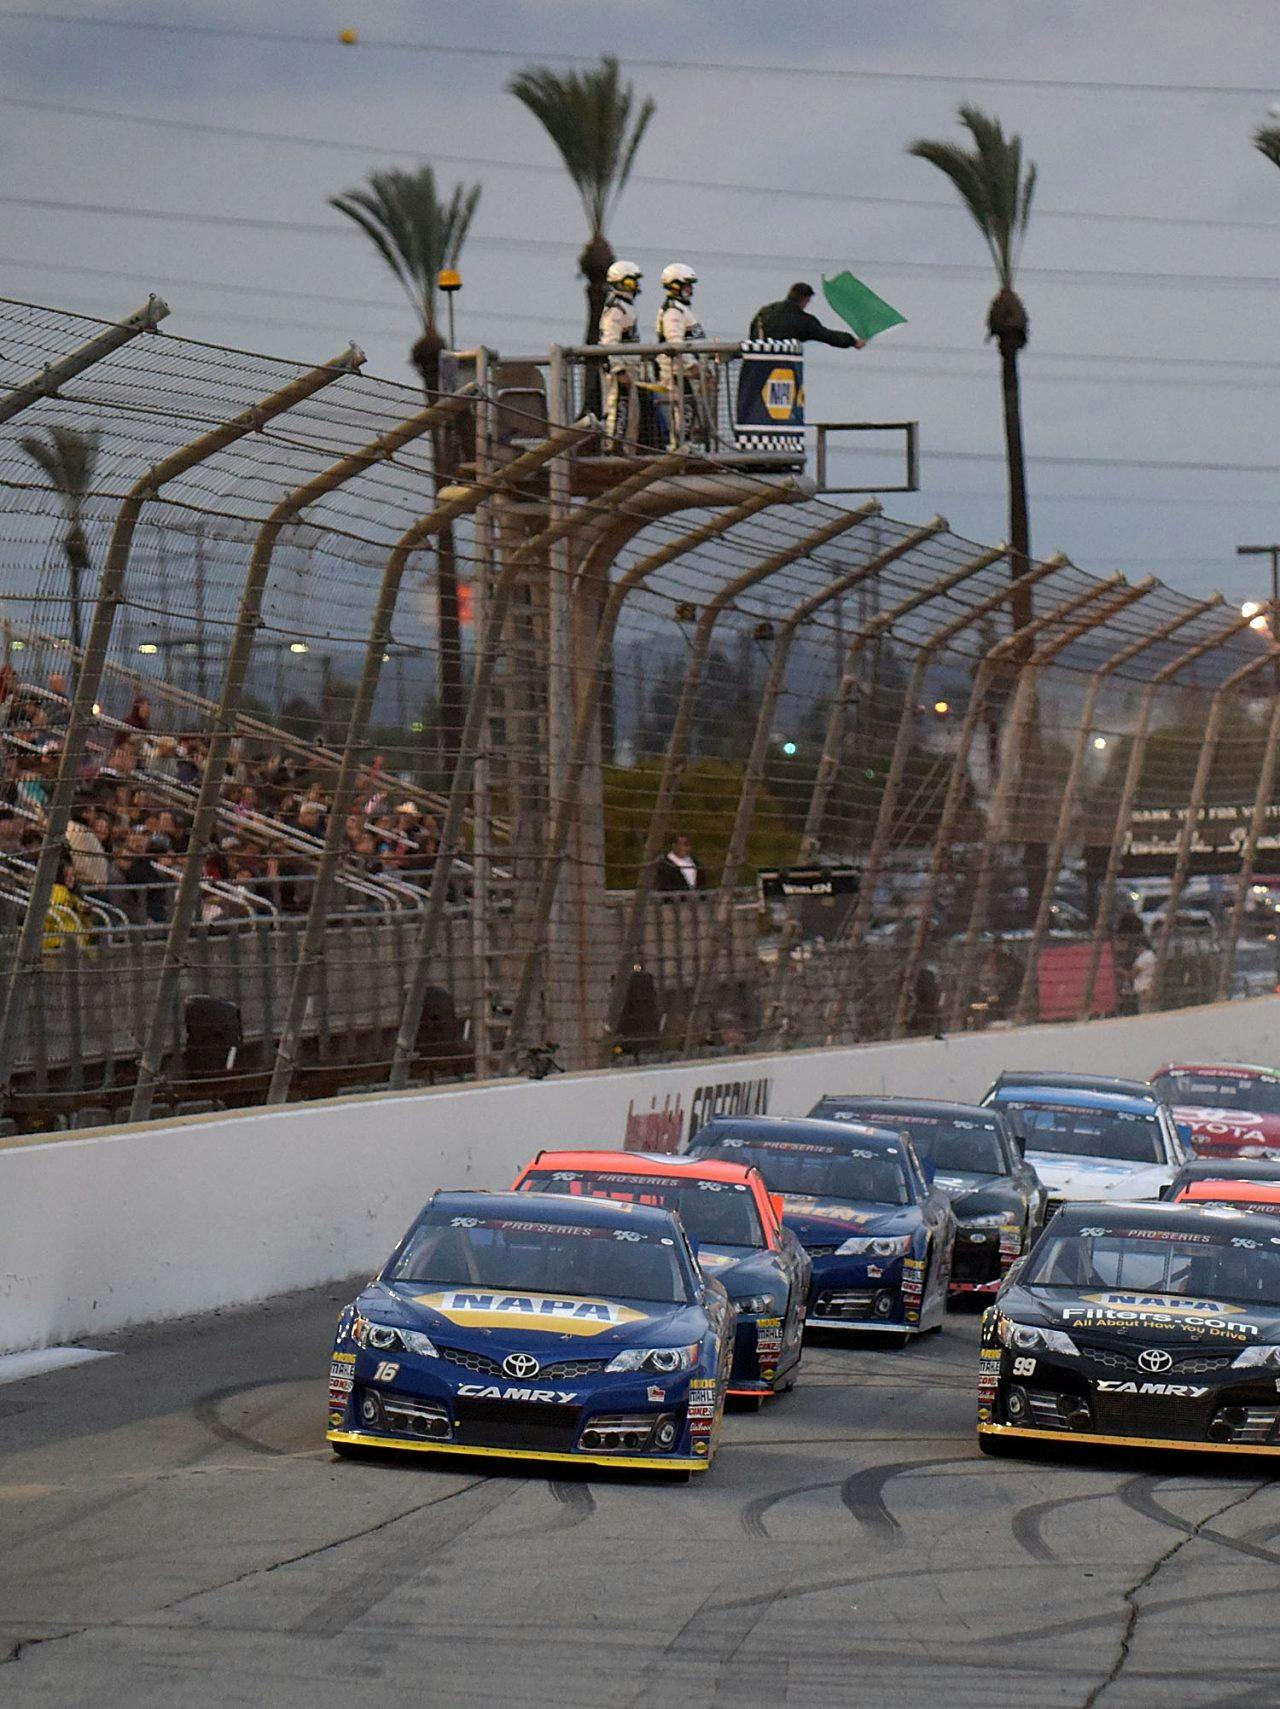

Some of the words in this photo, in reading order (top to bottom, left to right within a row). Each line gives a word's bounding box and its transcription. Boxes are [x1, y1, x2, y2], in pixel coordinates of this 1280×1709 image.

[596, 1174, 624, 1183] PRO
[626, 1175, 681, 1188] SERIES
[1248, 1203, 1274, 1213] PRO
[501, 1221, 533, 1232] PRO
[537, 1223, 593, 1236] SERIES
[1128, 1229, 1156, 1240] PRO
[1160, 1232, 1212, 1243] SERIES
[451, 1294, 613, 1321] NAPA
[1108, 1294, 1220, 1313] NAPA
[1073, 1319, 1092, 1328] All
[1096, 1319, 1140, 1328] About
[1143, 1320, 1175, 1330] How
[1180, 1324, 1206, 1335] You
[1209, 1327, 1248, 1342] Drive
[373, 1360, 401, 1383] 16
[1012, 1356, 1038, 1377] 99
[456, 1384, 579, 1404] CAMRY
[1096, 1379, 1209, 1397] CAMRY
